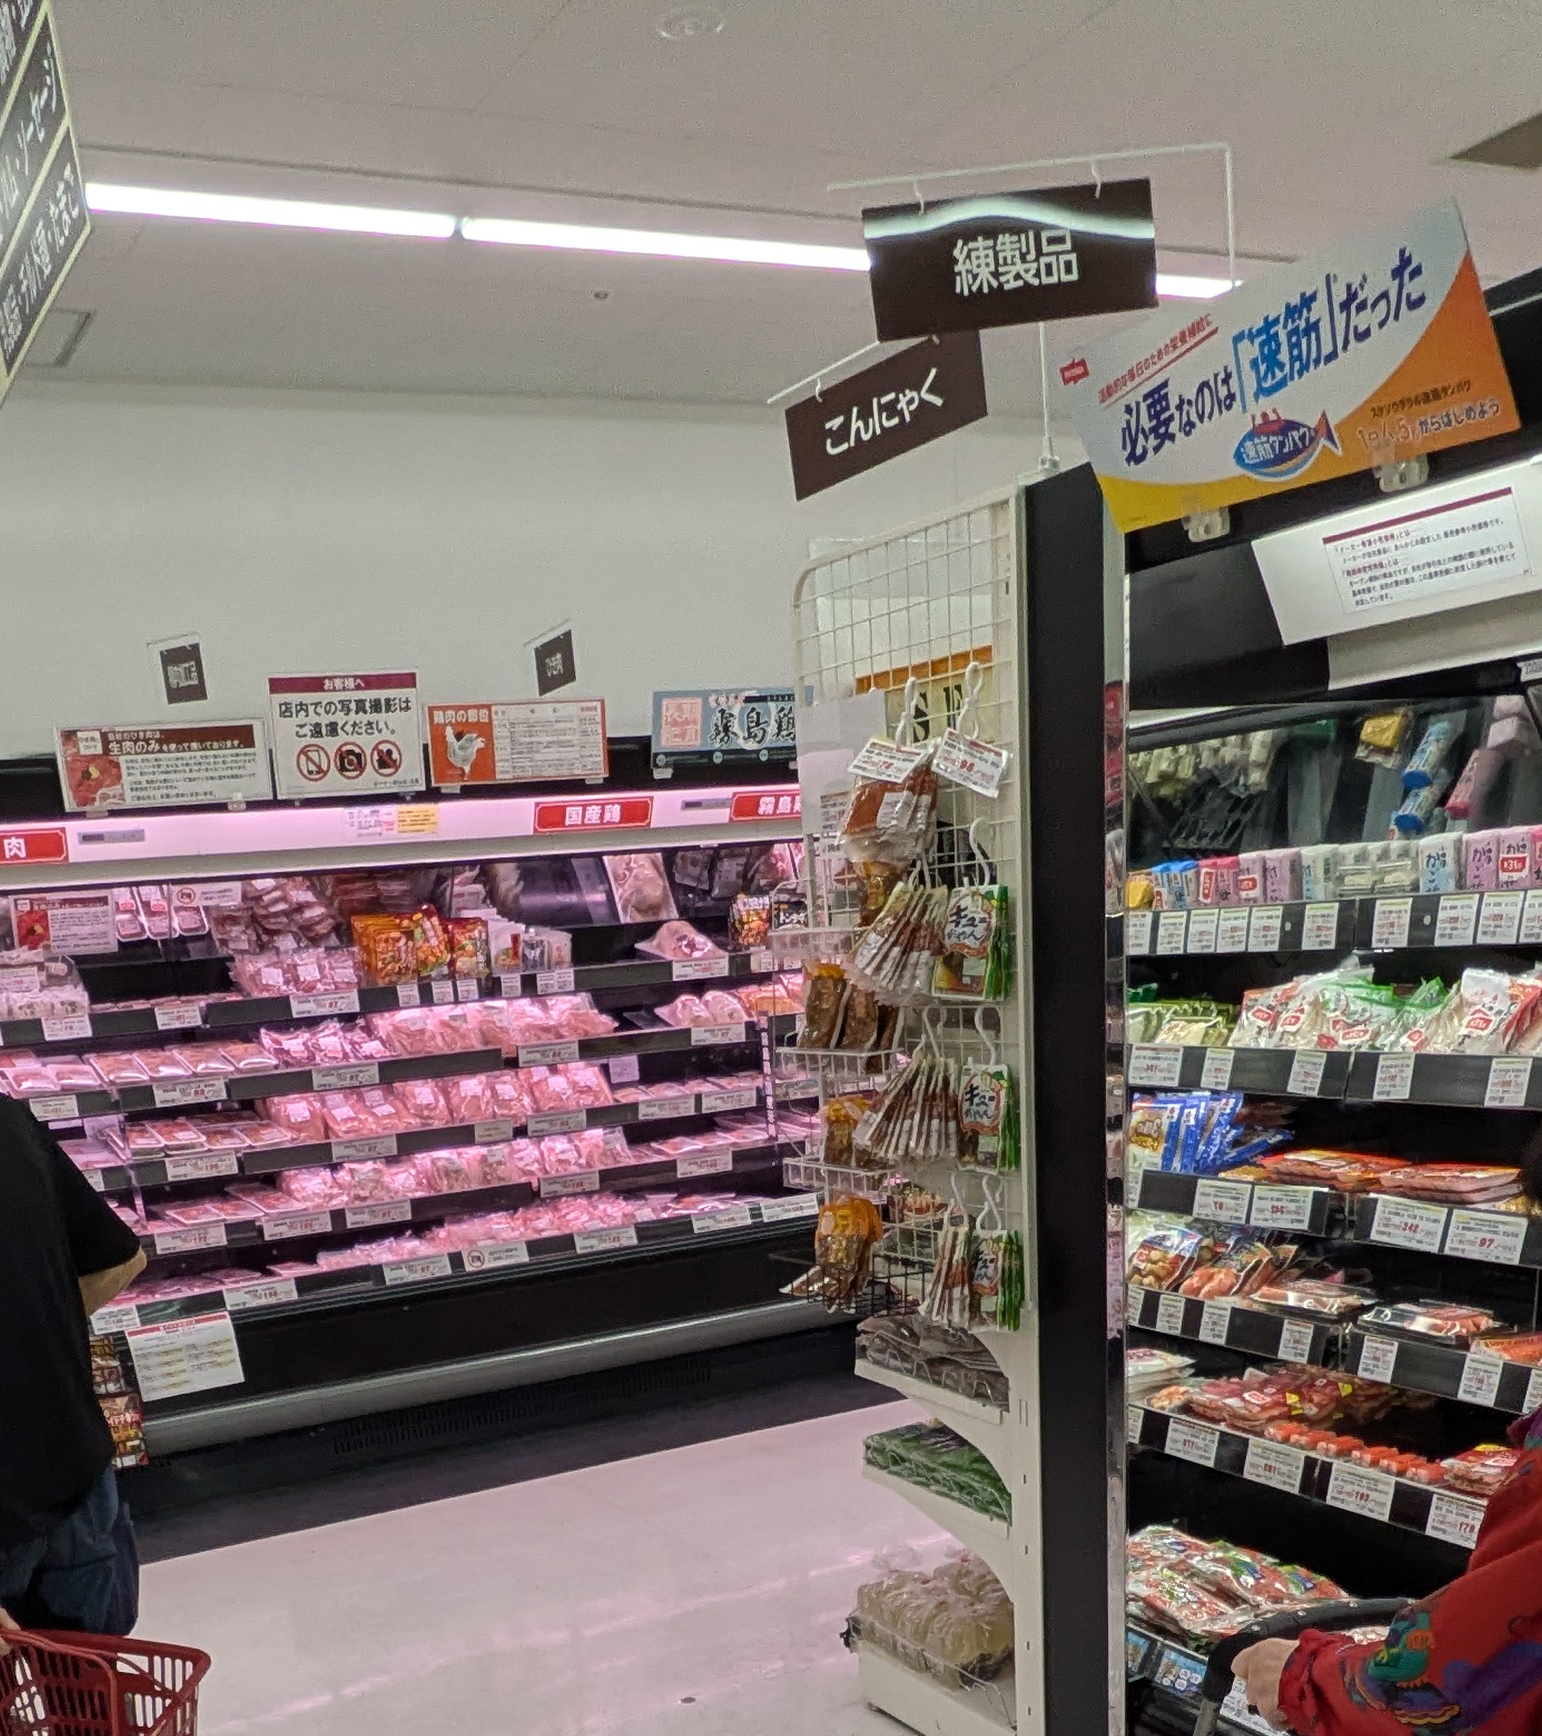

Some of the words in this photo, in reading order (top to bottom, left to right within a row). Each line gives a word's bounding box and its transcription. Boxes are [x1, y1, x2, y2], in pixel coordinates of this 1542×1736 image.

[953, 228, 1079, 297] 練製品
[1121, 246, 1427, 467] 必要なのは「速筋」だった
[824, 368, 944, 457] こんにゃく
[323, 678, 365, 691] お客様へ
[278, 697, 412, 719] 店内での写真撮影は
[295, 720, 396, 739] ご遠慮ください。
[564, 803, 622, 827] 国産鶏
